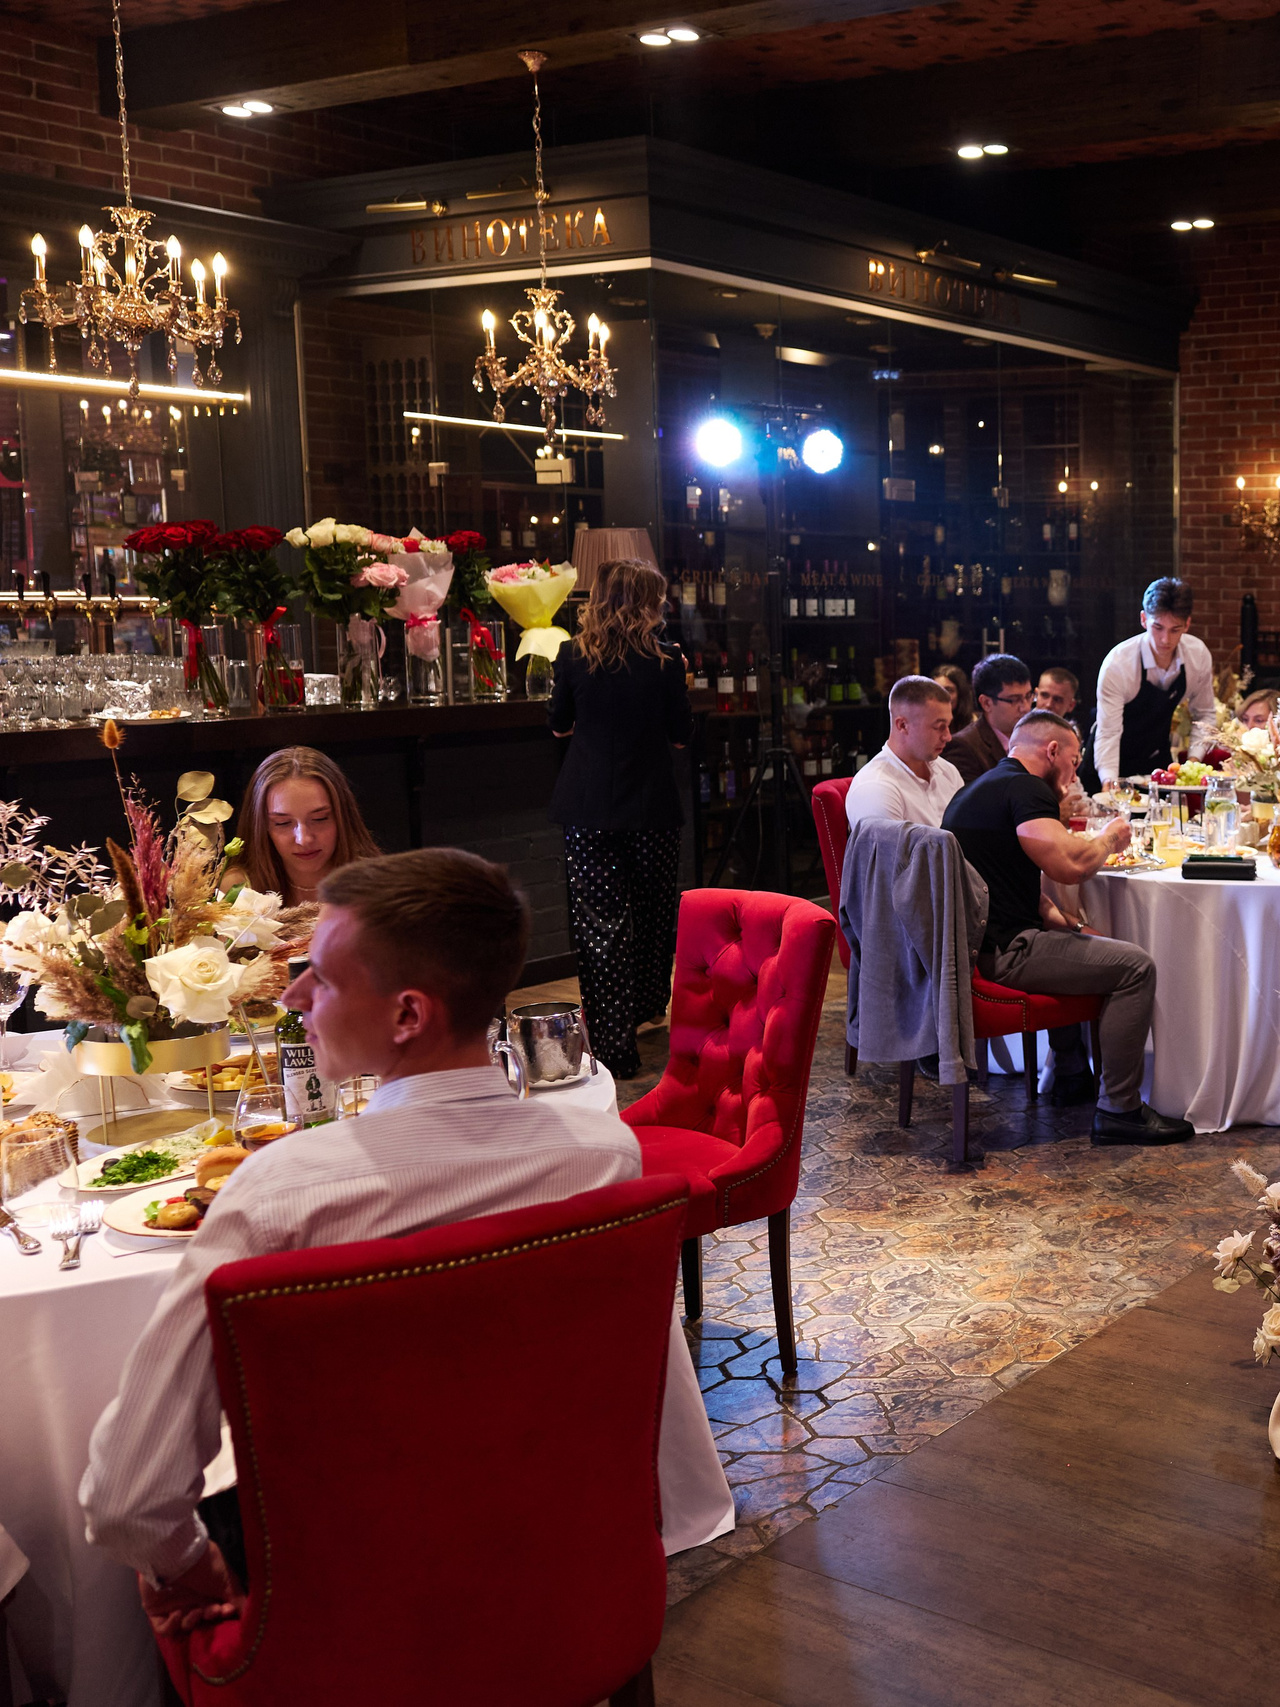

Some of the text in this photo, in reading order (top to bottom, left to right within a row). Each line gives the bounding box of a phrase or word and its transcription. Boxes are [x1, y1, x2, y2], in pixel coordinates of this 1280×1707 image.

[410, 206, 614, 264] ВИНОТЕКА
[801, 572, 834, 587] MEAT
[850, 573, 883, 588] WINE
[286, 1048, 314, 1058] WILL
[284, 1056, 314, 1067] LAWS
